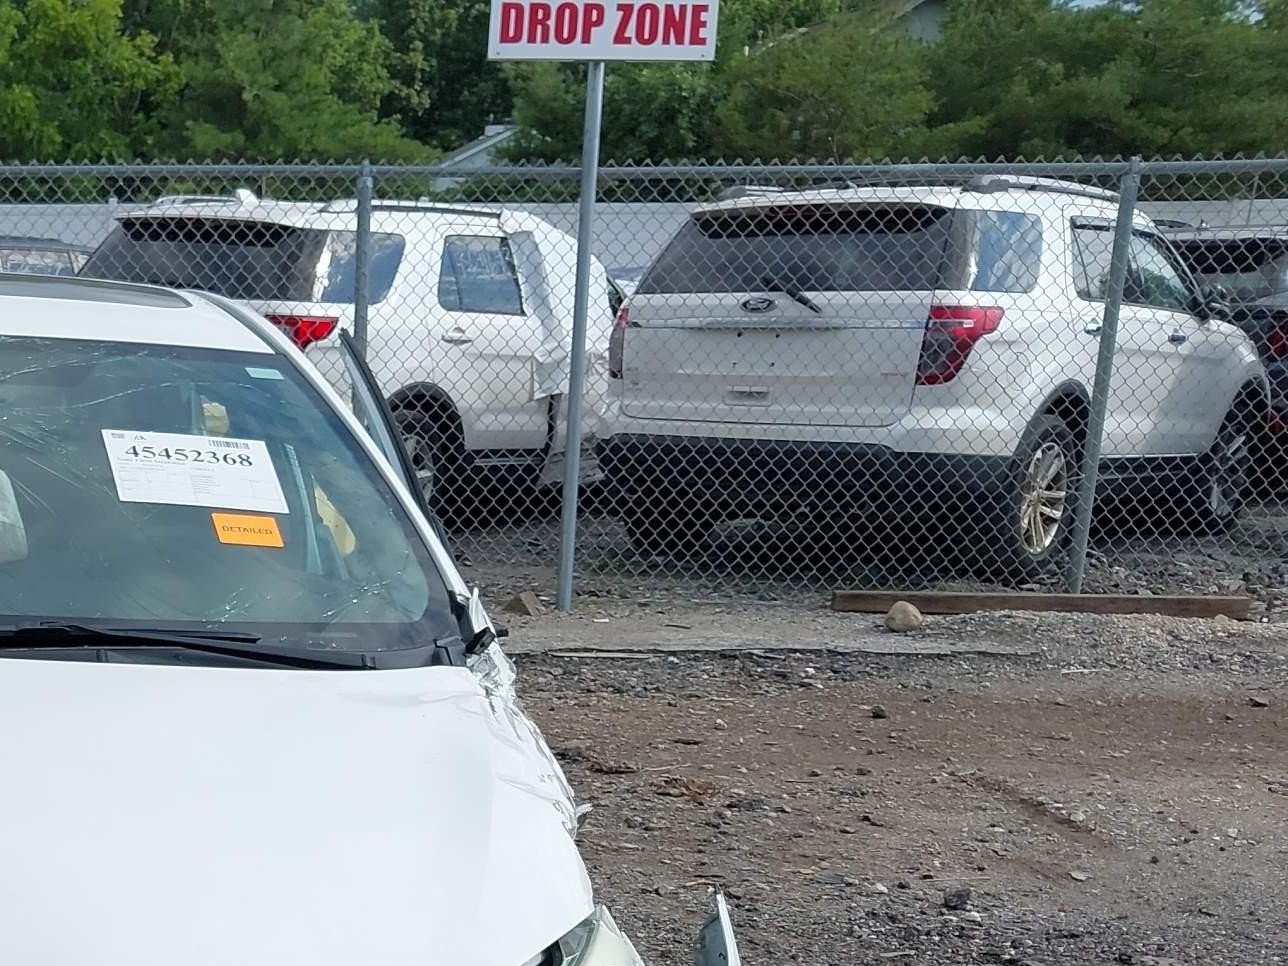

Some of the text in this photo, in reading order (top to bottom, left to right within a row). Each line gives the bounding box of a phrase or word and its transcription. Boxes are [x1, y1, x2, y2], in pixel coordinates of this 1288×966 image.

[499, 2, 710, 46] DROP ZONE
[125, 444, 253, 467] 45452368
[221, 525, 273, 535] DETAILED
